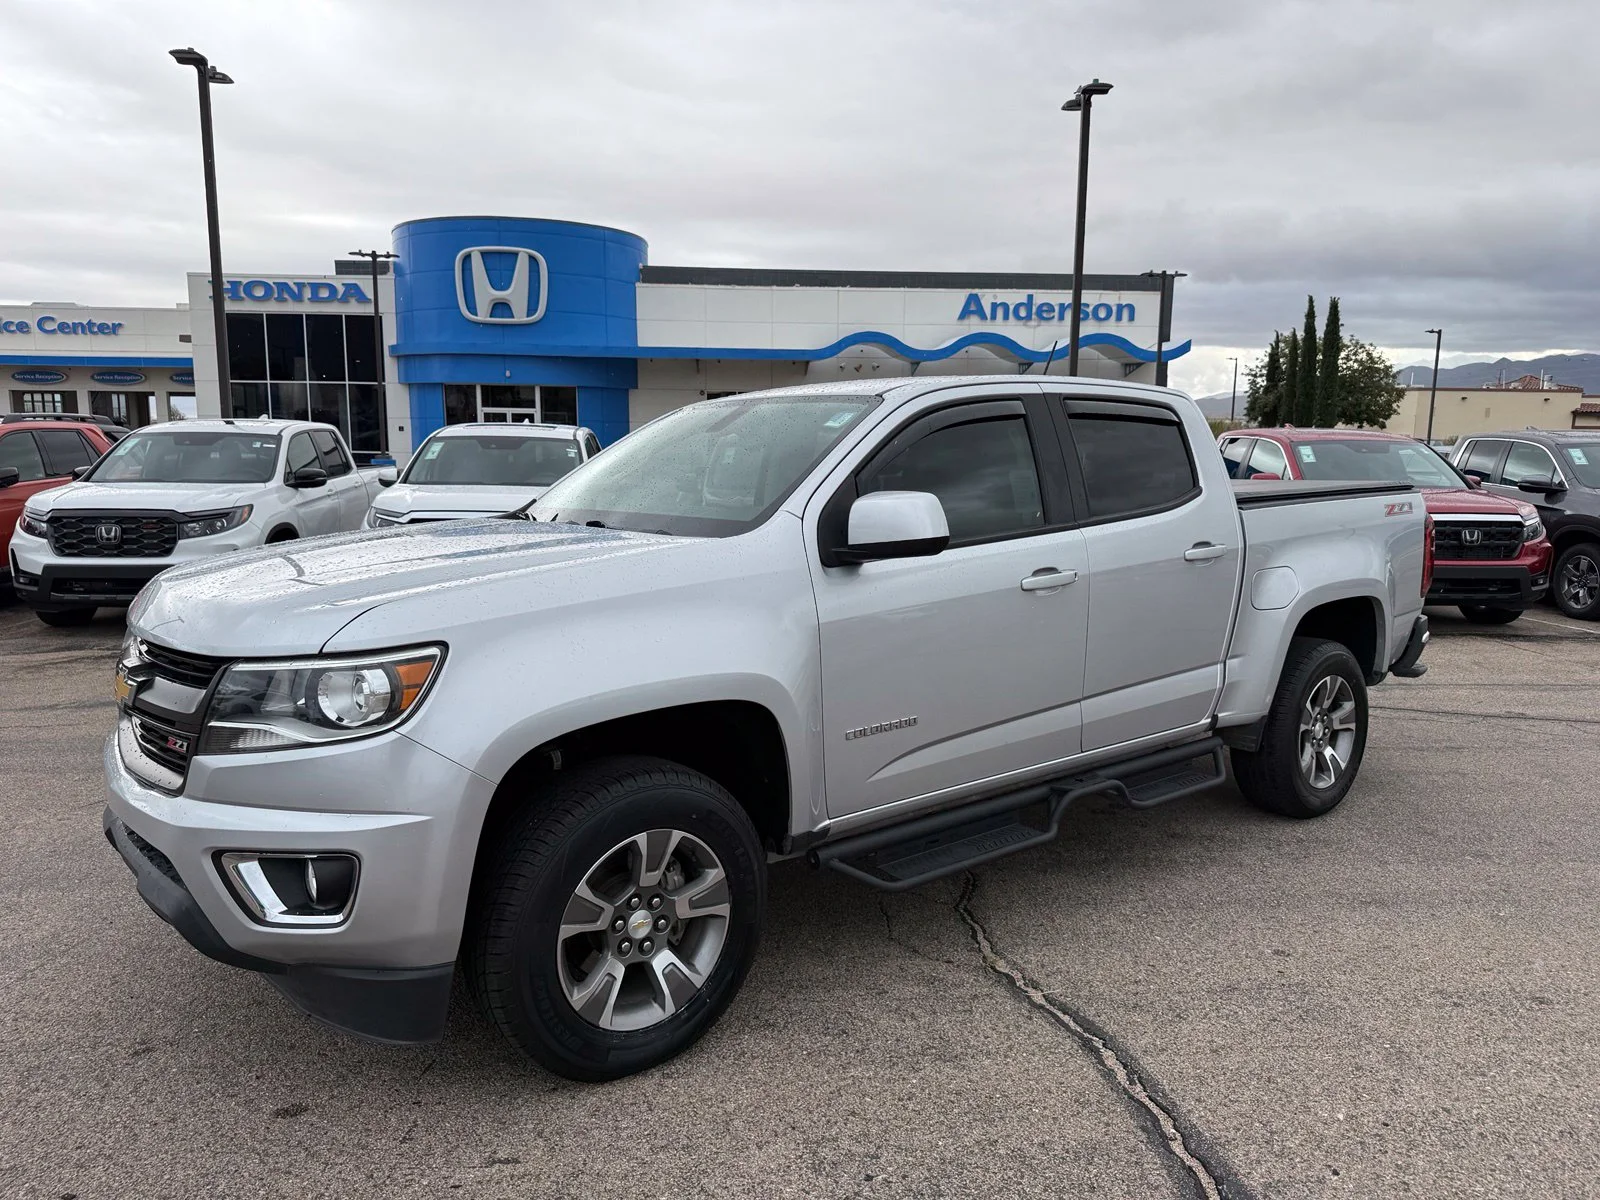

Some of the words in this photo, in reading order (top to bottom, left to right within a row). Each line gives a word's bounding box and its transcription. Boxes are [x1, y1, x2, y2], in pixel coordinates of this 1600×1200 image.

[208, 280, 372, 303] HONDA
[957, 293, 1136, 322] Anderson
[37, 316, 123, 335] Center
[1384, 502, 1413, 517] Z71
[846, 716, 918, 740] COLORADO
[167, 736, 187, 753] Z71
